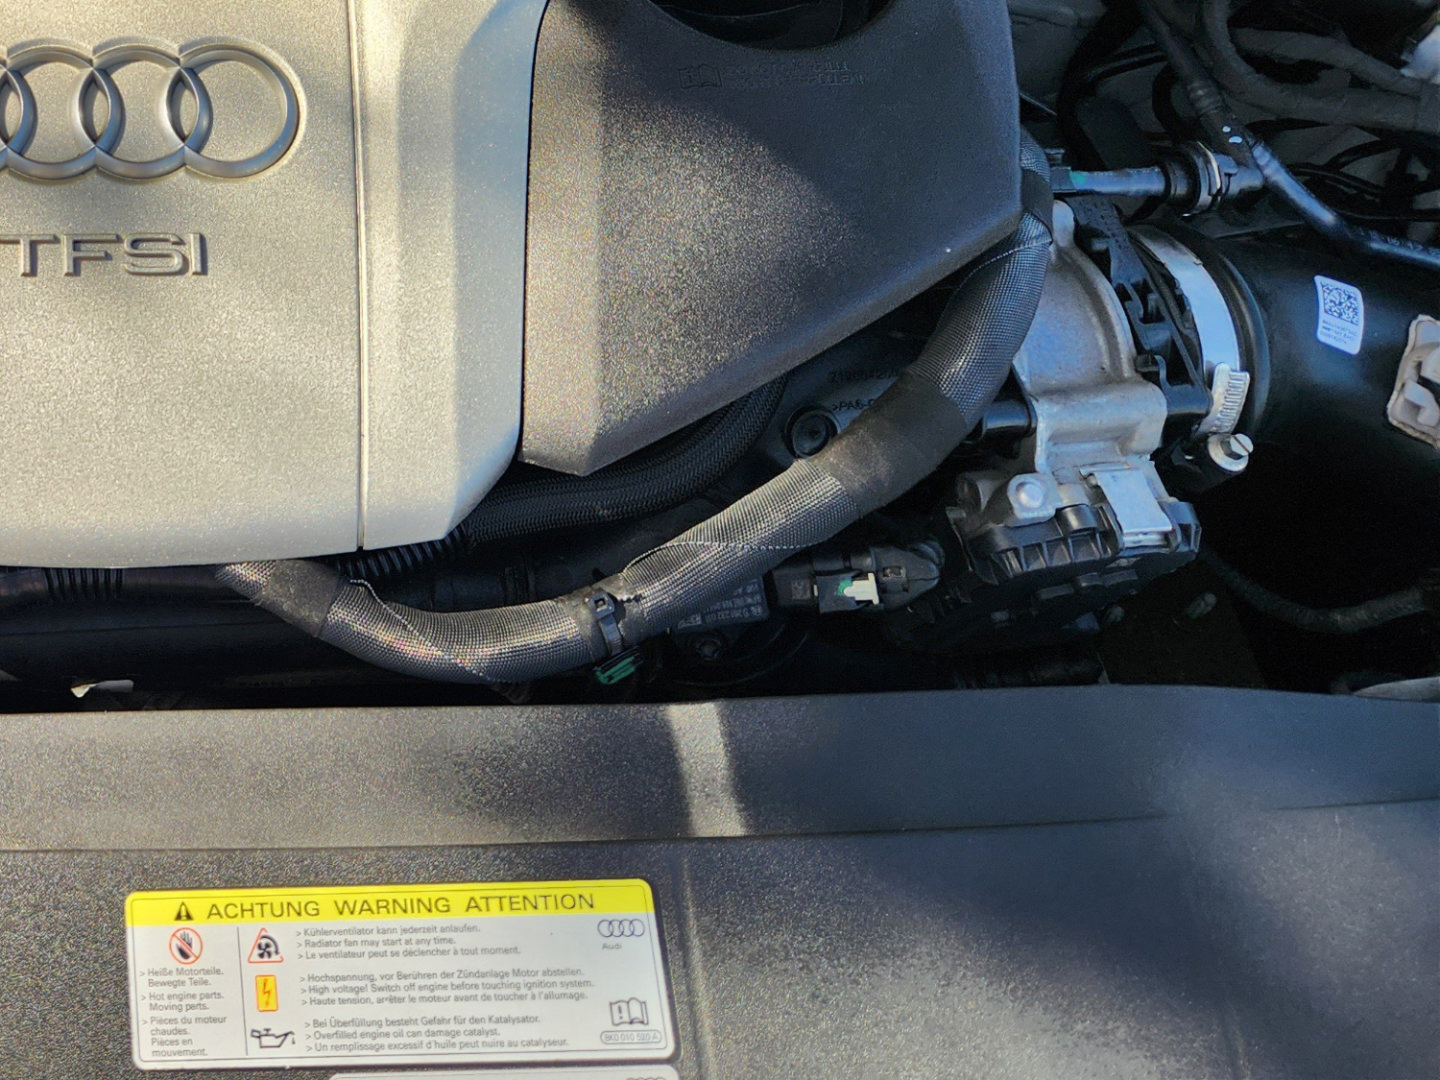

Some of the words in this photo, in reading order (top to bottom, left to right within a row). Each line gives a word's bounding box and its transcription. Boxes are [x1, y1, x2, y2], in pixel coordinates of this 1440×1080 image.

[207, 900, 320, 919] ACHTUNG
[334, 897, 451, 916] WARNING
[465, 893, 594, 912] ATTENTION
[304, 926, 374, 936] Kühlerventilator
[377, 925, 397, 934] kann
[400, 924, 437, 934] jederzeit
[440, 923, 480, 933] anlaufen.
[305, 938, 341, 947] Radiator
[344, 938, 358, 947] fan
[361, 938, 379, 949] may
[382, 937, 402, 946] start
[405, 937, 412, 946] at
[415, 937, 431, 947] any
[434, 936, 456, 944] time.
[306, 950, 316, 959] Le
[319, 950, 365, 959] ventilateur
[368, 950, 388, 960] peut
[391, 949, 399, 957] se
[453, 947, 457, 955] à
[460, 947, 478, 955] tout
[481, 946, 521, 955] moment.
[176, 967, 224, 976] Motorteile.
[308, 973, 378, 983] Hochspannung,
[397, 970, 437, 980] Berühren
[440, 970, 454, 979] der
[457, 969, 510, 980] Zündanlage
[512, 968, 539, 977] Motor
[542, 967, 584, 976] abstellen.
[148, 978, 186, 988] Bewegte
[189, 977, 211, 986] Teile.
[309, 984, 329, 994] High
[371, 983, 399, 992] Switch
[403, 982, 415, 992] off
[418, 983, 448, 993] engine
[451, 981, 479, 991] before
[482, 981, 521, 991] touching
[523, 980, 557, 990] ignition
[560, 979, 594, 988] system.
[149, 992, 164, 1001] Hot
[167, 992, 197, 1002] engine
[200, 991, 224, 1000] parts.
[310, 996, 336, 1005] Haute
[338, 996, 373, 1005] tension,
[409, 994, 416, 1003] le
[419, 994, 451, 1003] moteur
[454, 994, 478, 1002] avant
[481, 992, 491, 1001] de
[494, 992, 527, 1001] toucher
[531, 992, 535, 1000] à
[150, 1002, 183, 1013] Moving
[185, 1002, 209, 1011] parts.
[150, 1015, 178, 1025] Pièces
[181, 1015, 192, 1024] du
[195, 1015, 227, 1023] moteur
[313, 1019, 326, 1028] Bei
[330, 1016, 382, 1028] Überfüllung
[386, 1017, 418, 1026] besteht
[421, 1016, 450, 1026] Gefahr
[453, 1016, 466, 1025] für
[469, 1015, 485, 1024] den
[488, 1015, 541, 1025] Katalysator.
[151, 1026, 190, 1035] chaudes.
[314, 1030, 357, 1039] Overfilled
[360, 1030, 391, 1040] engine
[393, 1029, 403, 1037] oil
[406, 1028, 422, 1038] can
[425, 1028, 461, 1038] damage
[464, 1028, 500, 1037] catalyst.
[151, 1037, 179, 1046] Pièces
[181, 1037, 193, 1045] en
[315, 1042, 327, 1051] Un
[331, 1042, 385, 1052] remplissage
[388, 1041, 424, 1049] excessif
[460, 1040, 478, 1049] peut
[481, 1039, 504, 1048] nuire
[507, 1039, 518, 1047] au
[521, 1037, 569, 1048] catalyseur.
[152, 1048, 207, 1057] mouvement.
